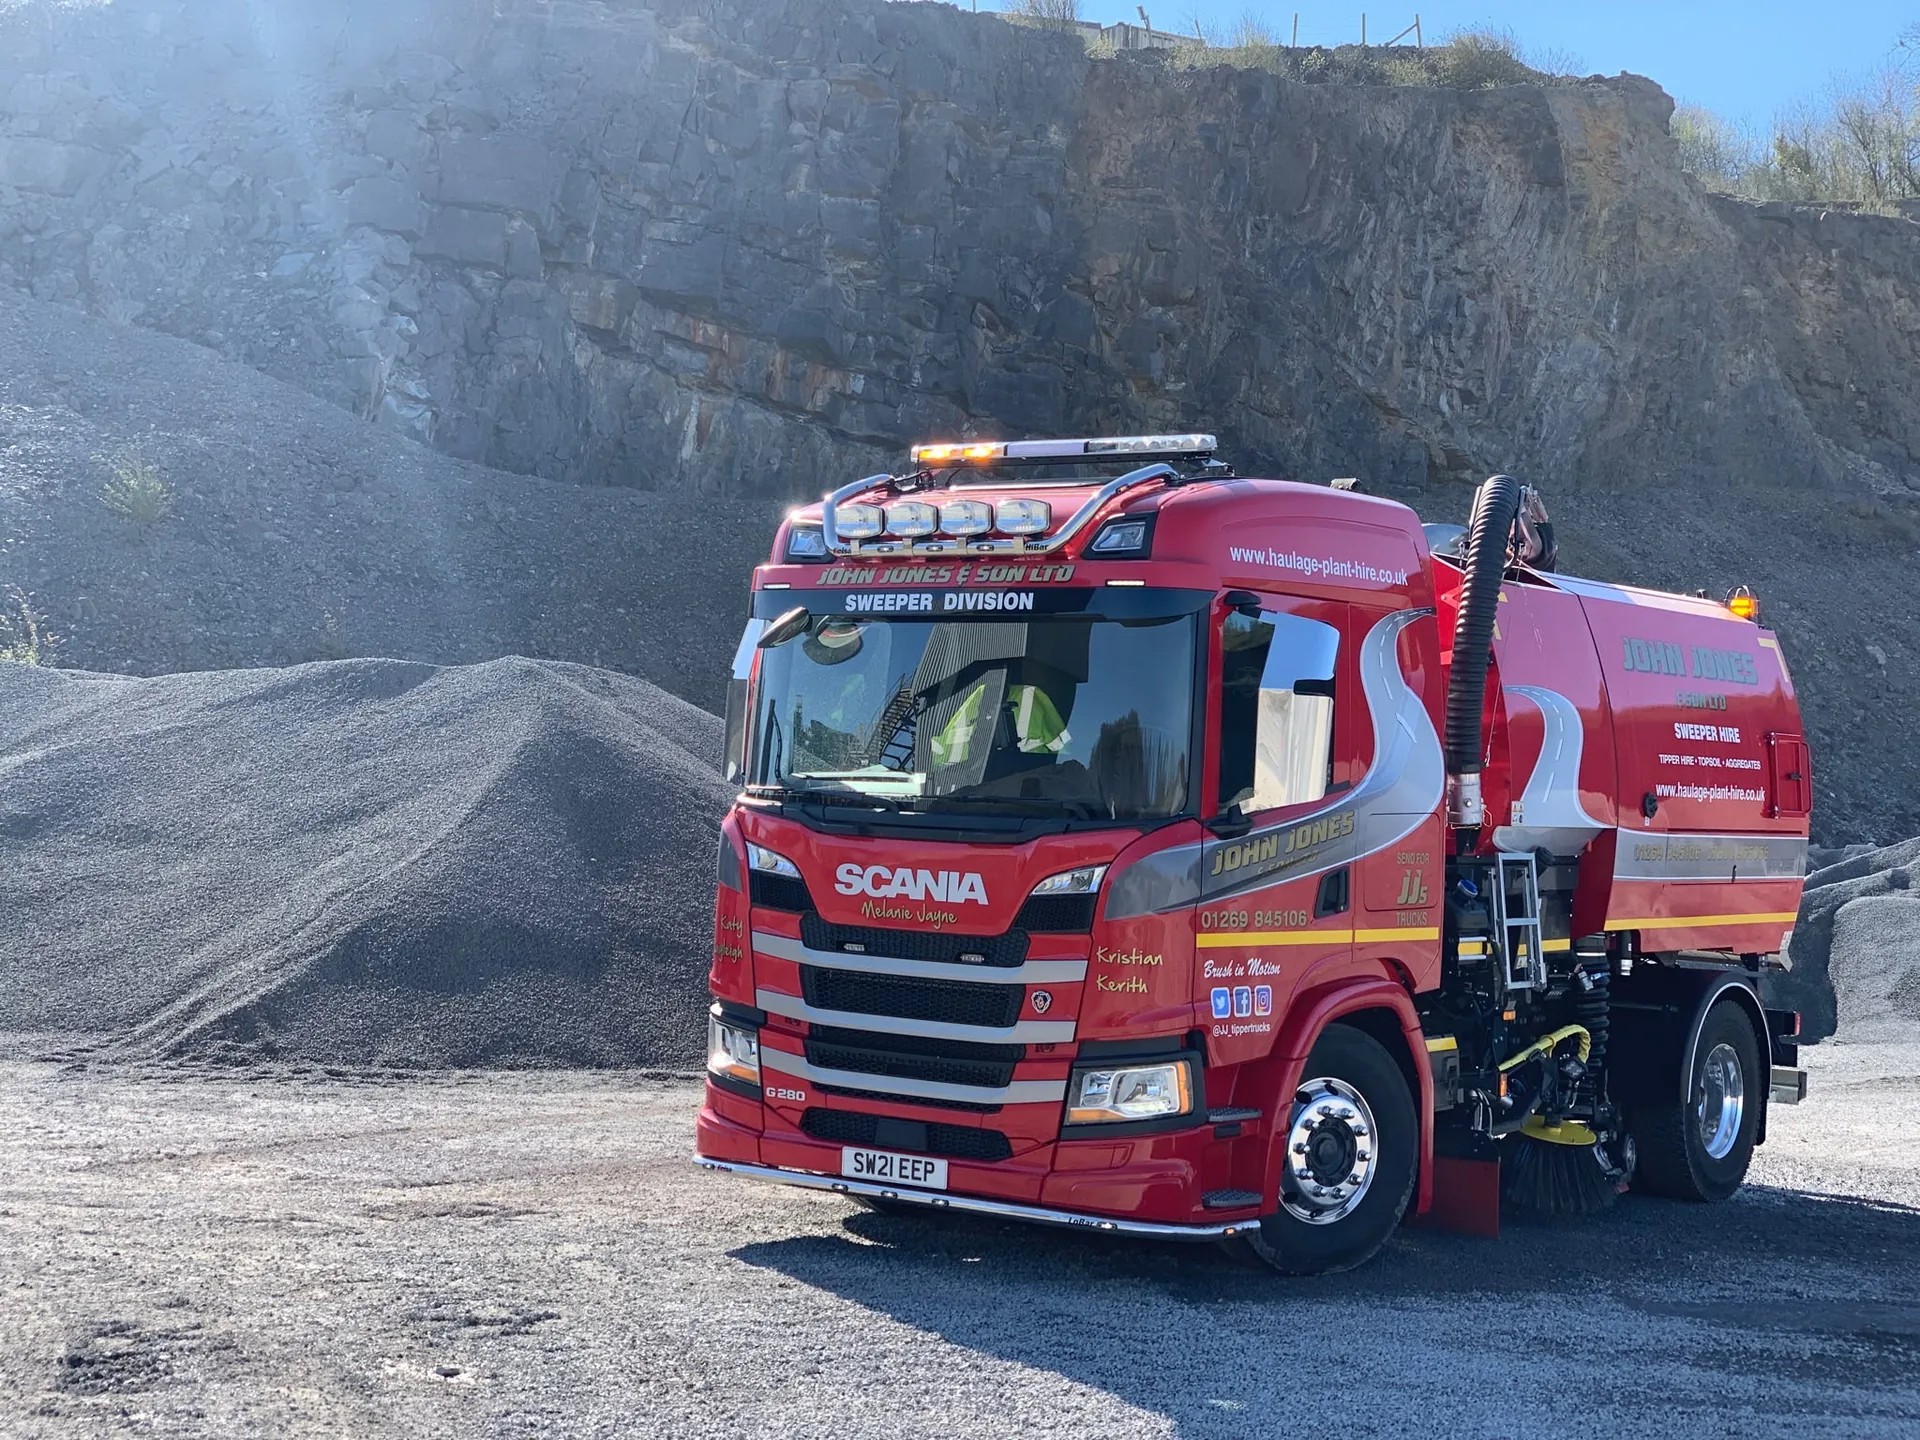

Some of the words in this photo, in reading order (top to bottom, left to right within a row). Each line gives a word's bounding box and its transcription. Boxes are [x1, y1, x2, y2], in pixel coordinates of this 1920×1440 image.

[817, 567, 879, 585] JOHN
[879, 566, 954, 584] JONES
[974, 565, 1024, 583] SON
[1029, 564, 1076, 582] LTD
[1230, 547, 1409, 586] www.haulage-plant-hire.co.uk
[845, 593, 933, 611] SWEEPER
[944, 592, 1034, 610] DIVISION
[1622, 637, 1687, 677] JOHN
[1691, 645, 1758, 685] JONES
[1708, 695, 1727, 711] LTD
[1674, 722, 1718, 742] SWEEPER
[1719, 726, 1741, 744] HIRE
[1659, 754, 1680, 765] TIPPER
[1681, 756, 1694, 765] HIRE
[1698, 756, 1722, 767] TOPSOIL
[1725, 759, 1761, 770] AGGREGATES
[1656, 782, 1766, 803] www.haulage-plant-hire.co.uk
[1211, 834, 1280, 876] JOHN
[1284, 810, 1355, 854] JONES
[1397, 853, 1415, 864] SEND
[1416, 853, 1430, 864] FOR
[834, 863, 989, 905] SCANIA
[861, 900, 913, 919] Melanie
[917, 903, 957, 929] Jayne
[1201, 911, 1248, 928] 01269
[1254, 910, 1307, 927] 845106
[1396, 912, 1427, 926] TRUCKS
[721, 914, 743, 939] Katy
[1096, 946, 1163, 966] Kristian
[1203, 959, 1234, 979] Brush
[1234, 963, 1245, 977] in
[1247, 957, 1281, 976] Motion
[1096, 974, 1148, 993] Kerith
[1212, 1022, 1271, 1038] @JJ_tippertrucks
[853, 1152, 894, 1178] SW21
[899, 1160, 935, 1182] EEP
[1068, 1216, 1093, 1227] LoBar
